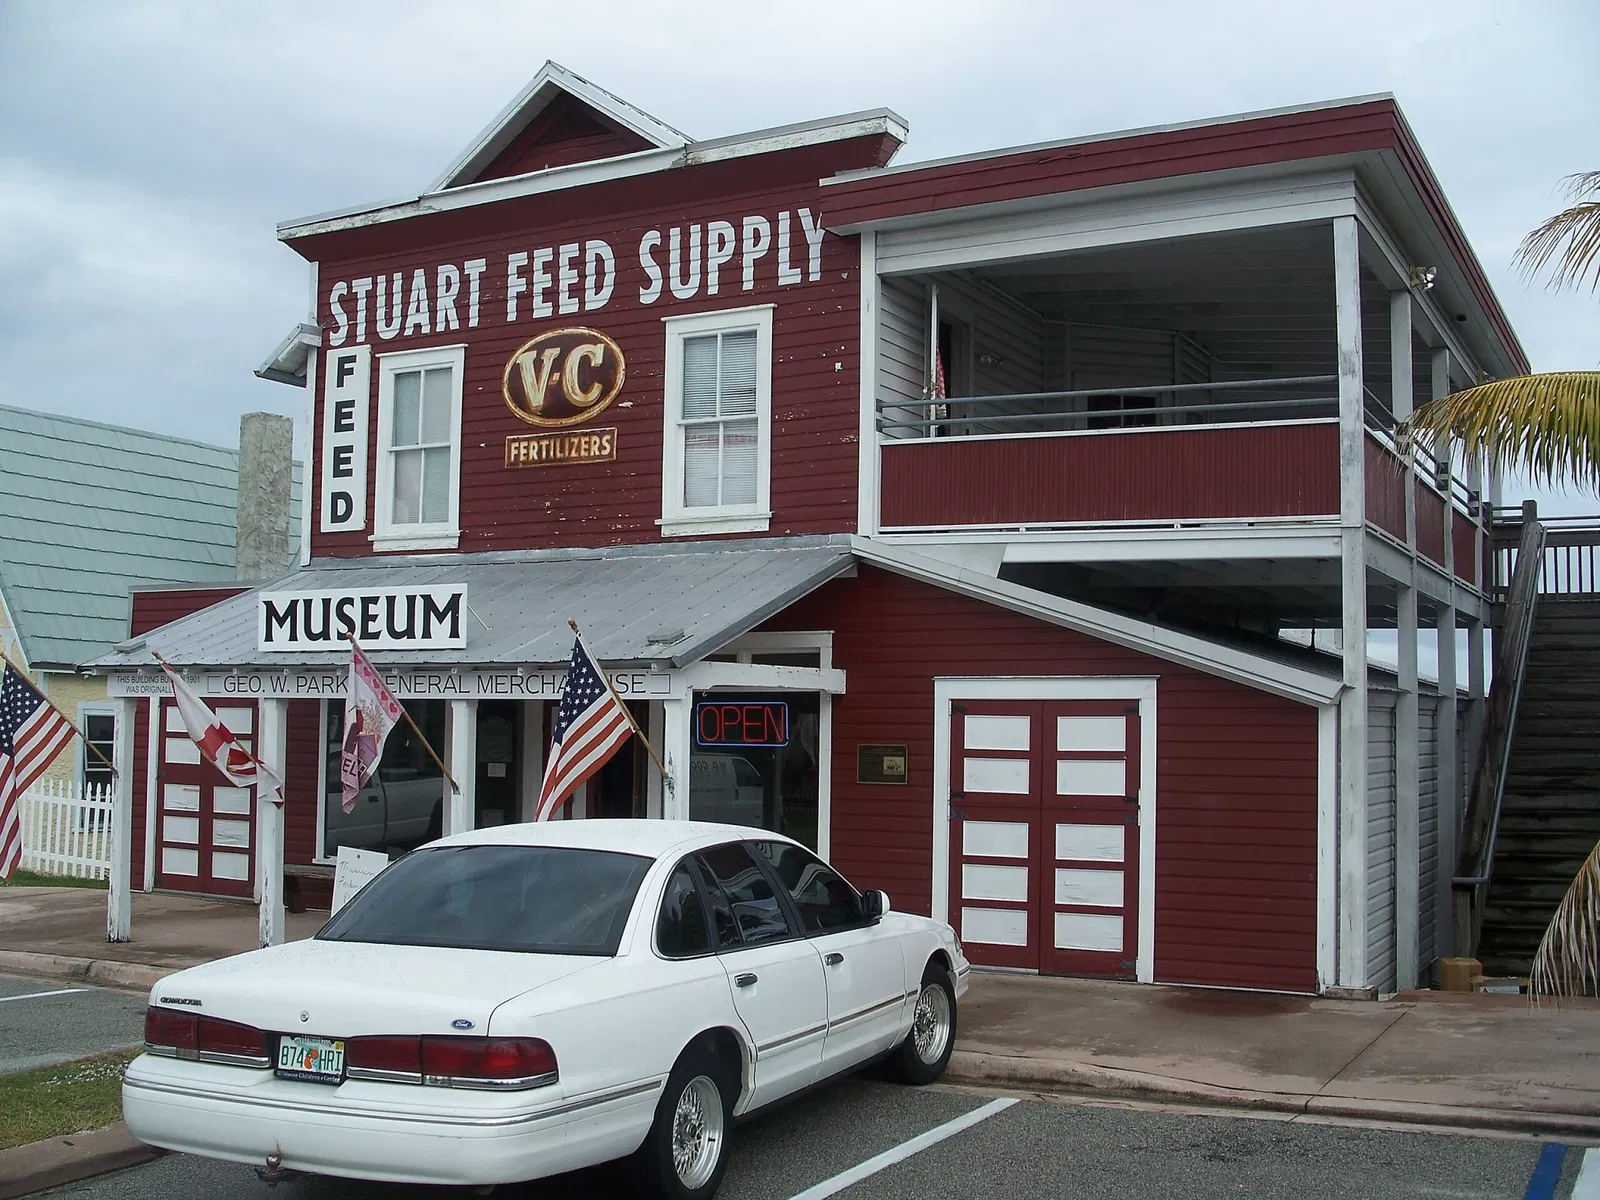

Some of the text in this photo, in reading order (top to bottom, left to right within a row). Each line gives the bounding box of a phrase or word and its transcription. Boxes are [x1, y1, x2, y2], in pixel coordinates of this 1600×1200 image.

[329, 207, 826, 347] STUART FEED SUPPLY
[516, 343, 604, 412] V-C
[330, 354, 357, 525] FEED
[510, 434, 612, 462] FERTILIZERS
[262, 593, 463, 642] MUSEUM
[117, 675, 131, 684] THIS
[131, 675, 159, 684] BUILDING
[186, 675, 200, 684] 1901
[125, 685, 173, 694] WAS ORIGINALL
[223, 675, 265, 693] GEO.
[269, 675, 290, 693] W.
[295, 675, 349, 694] PARK
[381, 674, 471, 694] ENERAL
[700, 705, 785, 742] OPEN
[281, 1045, 342, 1072] 874 HRI
